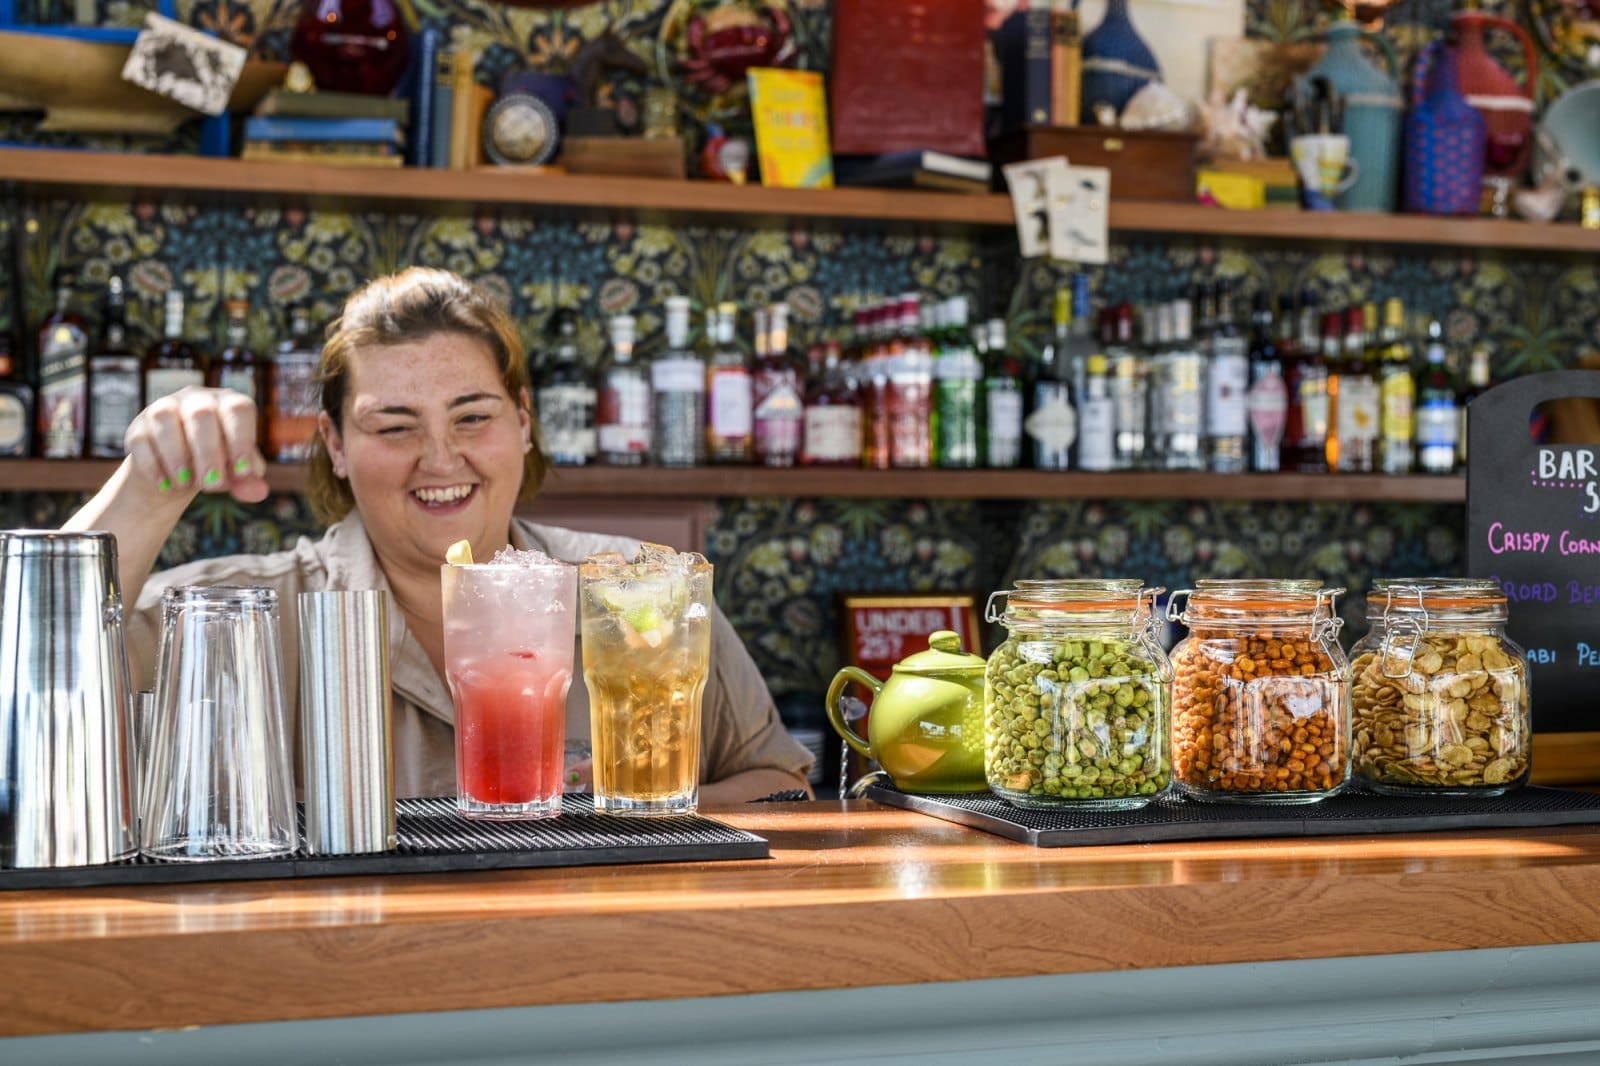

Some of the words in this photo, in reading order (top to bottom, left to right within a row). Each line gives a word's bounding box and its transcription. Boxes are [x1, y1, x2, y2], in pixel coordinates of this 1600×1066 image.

[1539, 449, 1598, 479] BAR
[1488, 522, 1550, 554] CRISPY
[854, 609, 945, 634] UNDER
